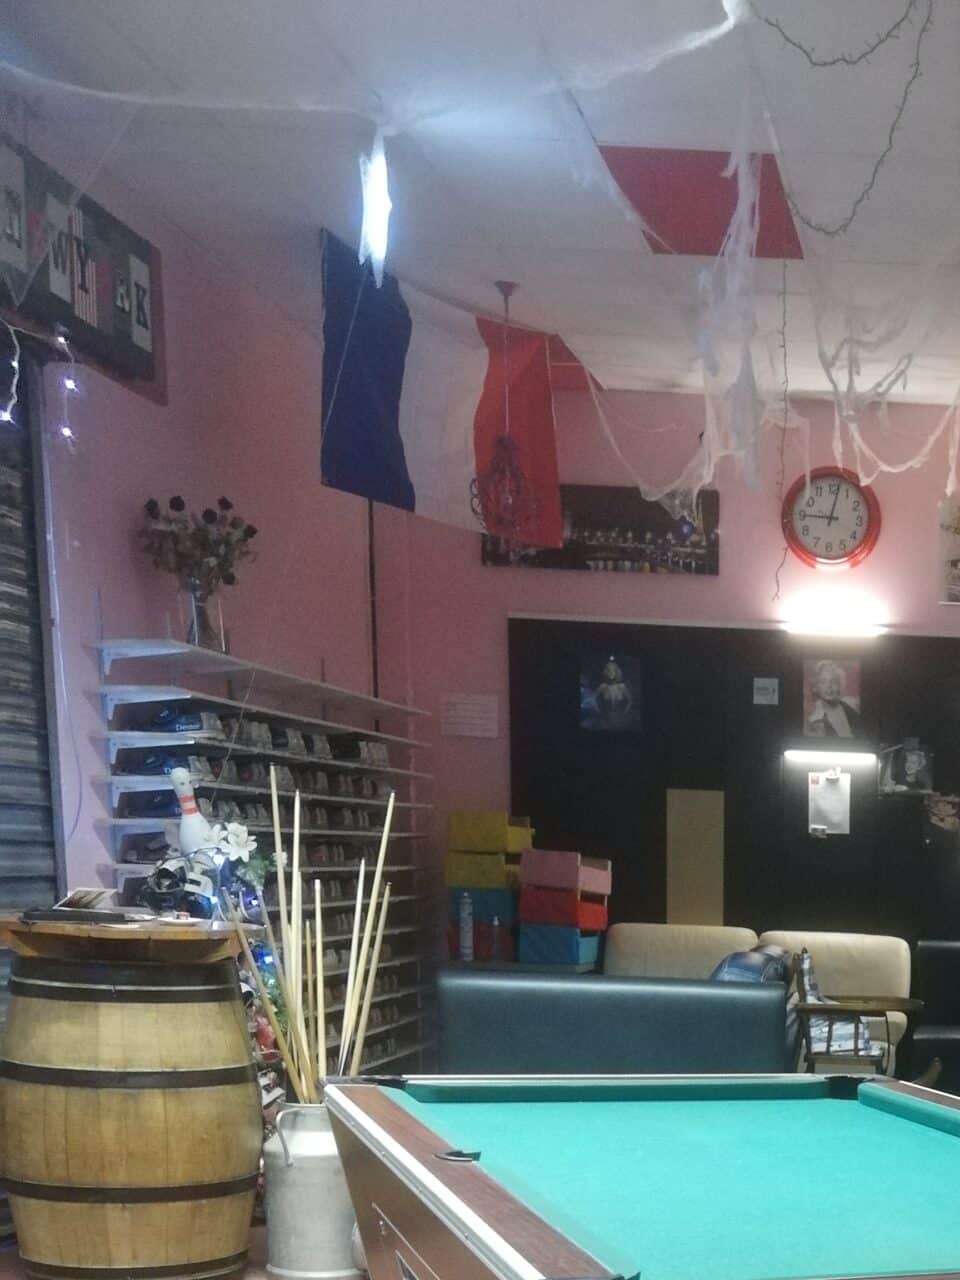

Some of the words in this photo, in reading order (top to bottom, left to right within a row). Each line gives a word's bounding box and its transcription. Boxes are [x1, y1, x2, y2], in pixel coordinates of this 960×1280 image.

[852, 500, 860, 512] 2
[855, 516, 863, 527] 3
[801, 525, 810, 536] 8
[849, 530, 857, 540] 4
[813, 536, 821, 547] 7
[825, 542, 833, 552] 6
[839, 539, 847, 551] 5
